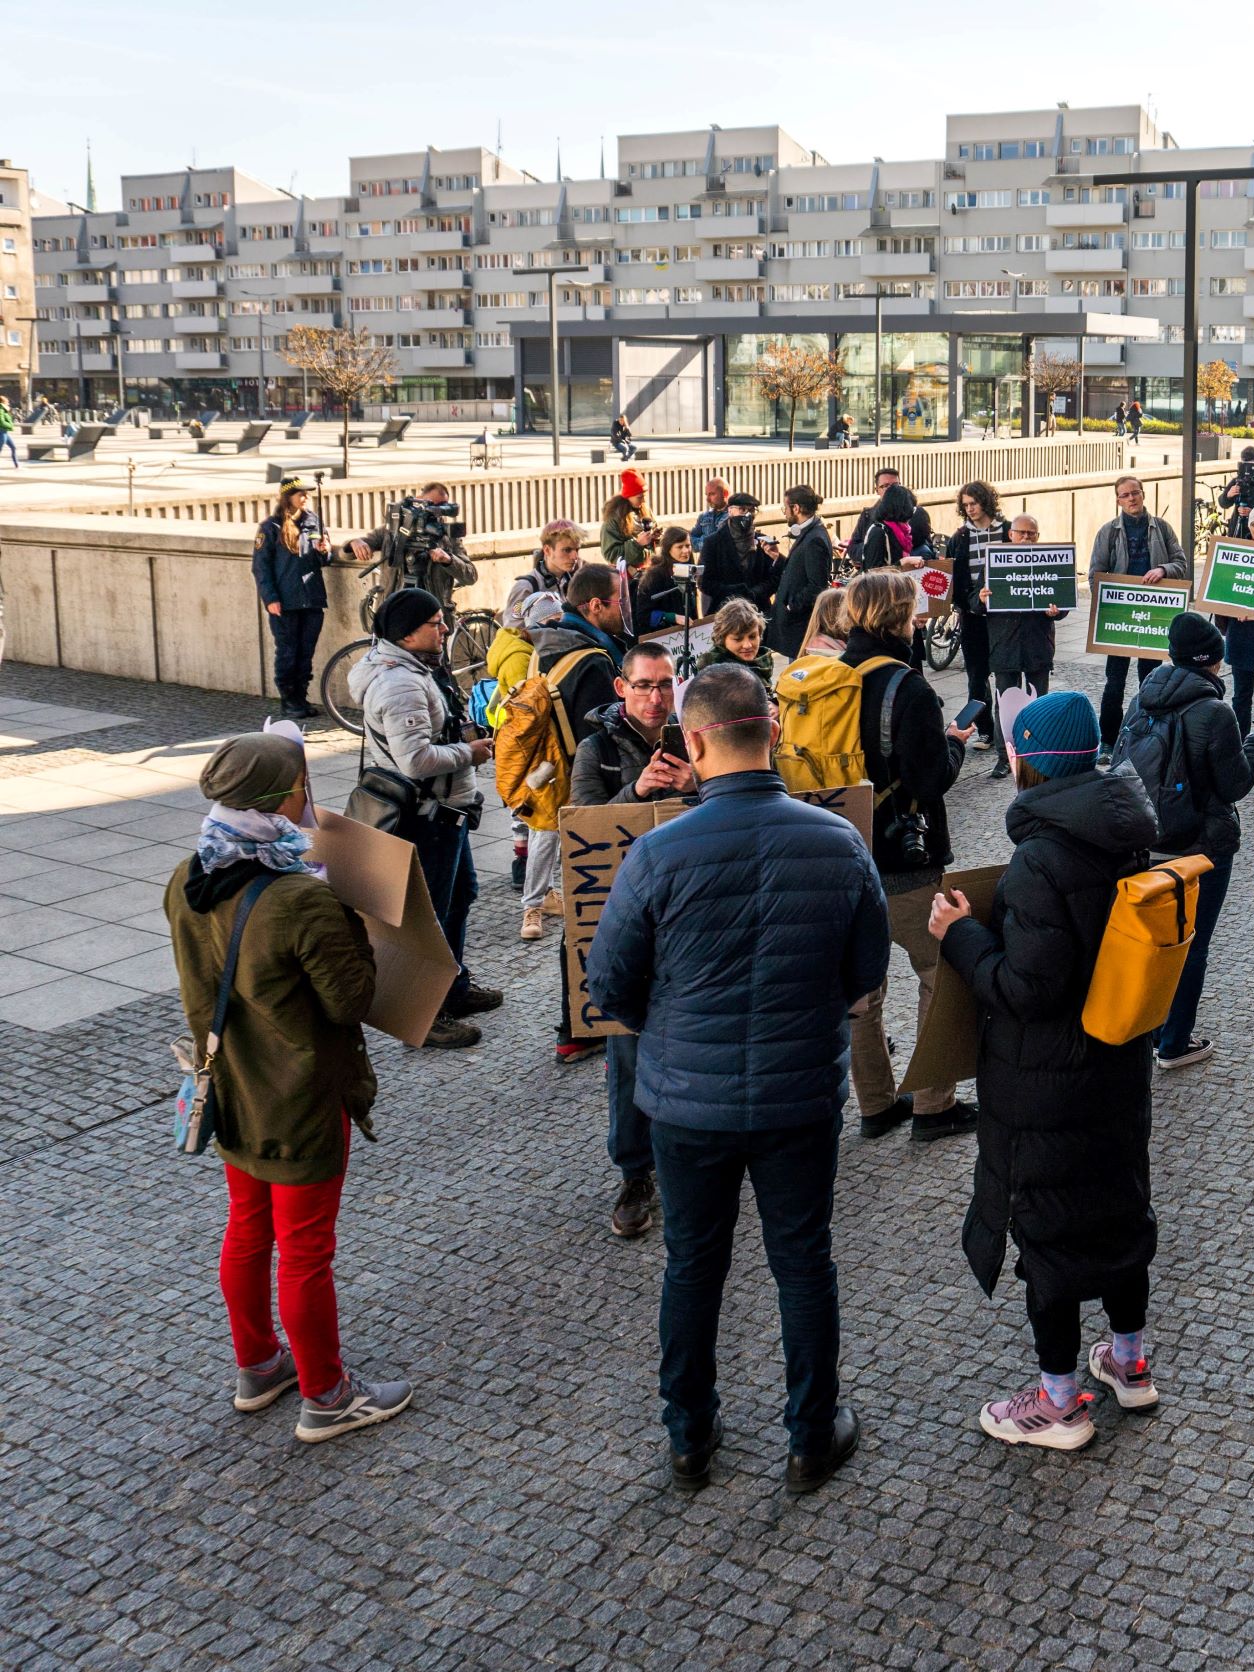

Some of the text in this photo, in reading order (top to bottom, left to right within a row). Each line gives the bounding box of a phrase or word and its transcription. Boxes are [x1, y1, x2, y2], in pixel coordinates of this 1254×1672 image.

[994, 553, 1069, 564] NIE ODDAMY!
[1221, 551, 1240, 562] NIE
[1010, 585, 1054, 598] krzycka
[1106, 590, 1180, 606] NIE ODDAMY!
